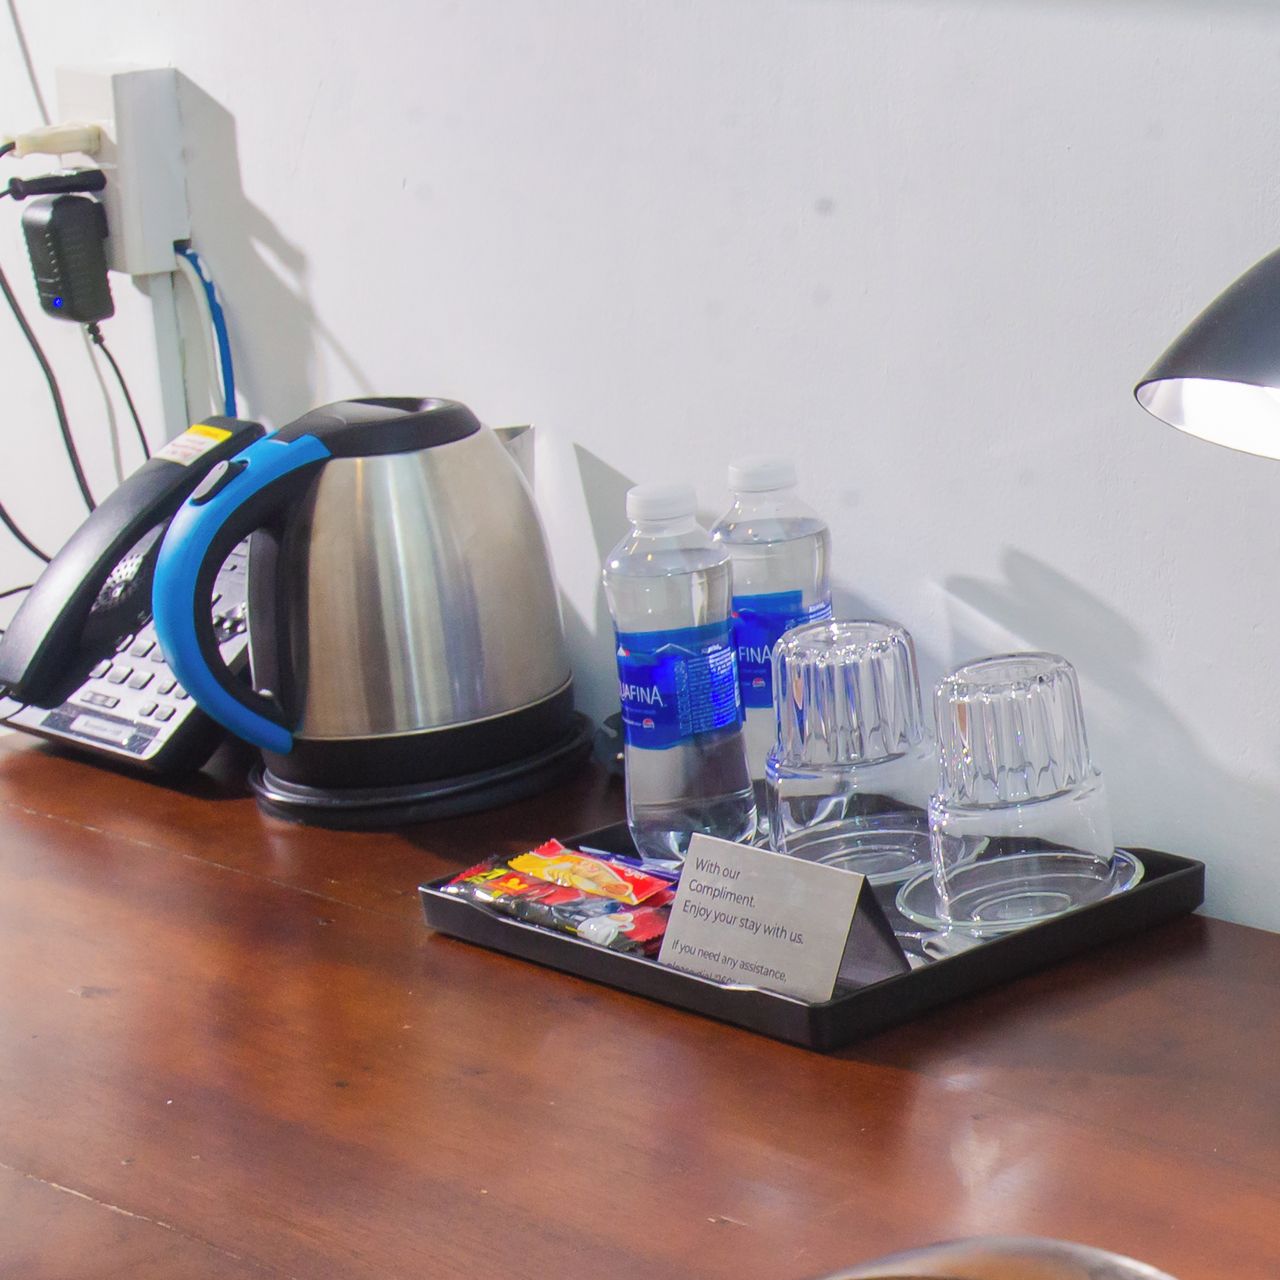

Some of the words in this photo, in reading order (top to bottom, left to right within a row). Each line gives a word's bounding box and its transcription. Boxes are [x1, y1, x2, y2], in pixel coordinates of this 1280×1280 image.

[695, 856, 721, 877] With
[722, 866, 741, 881] our
[688, 878, 756, 908] Compliment.
[682, 899, 712, 922] Enjoy
[713, 910, 739, 927] your
[739, 916, 762, 935] stay
[763, 922, 787, 940] with
[789, 928, 804, 945] us.
[671, 939, 680, 950] If
[680, 943, 697, 955] you
[697, 947, 721, 962] need
[721, 955, 739, 970] any
[739, 960, 787, 984] assistance,
